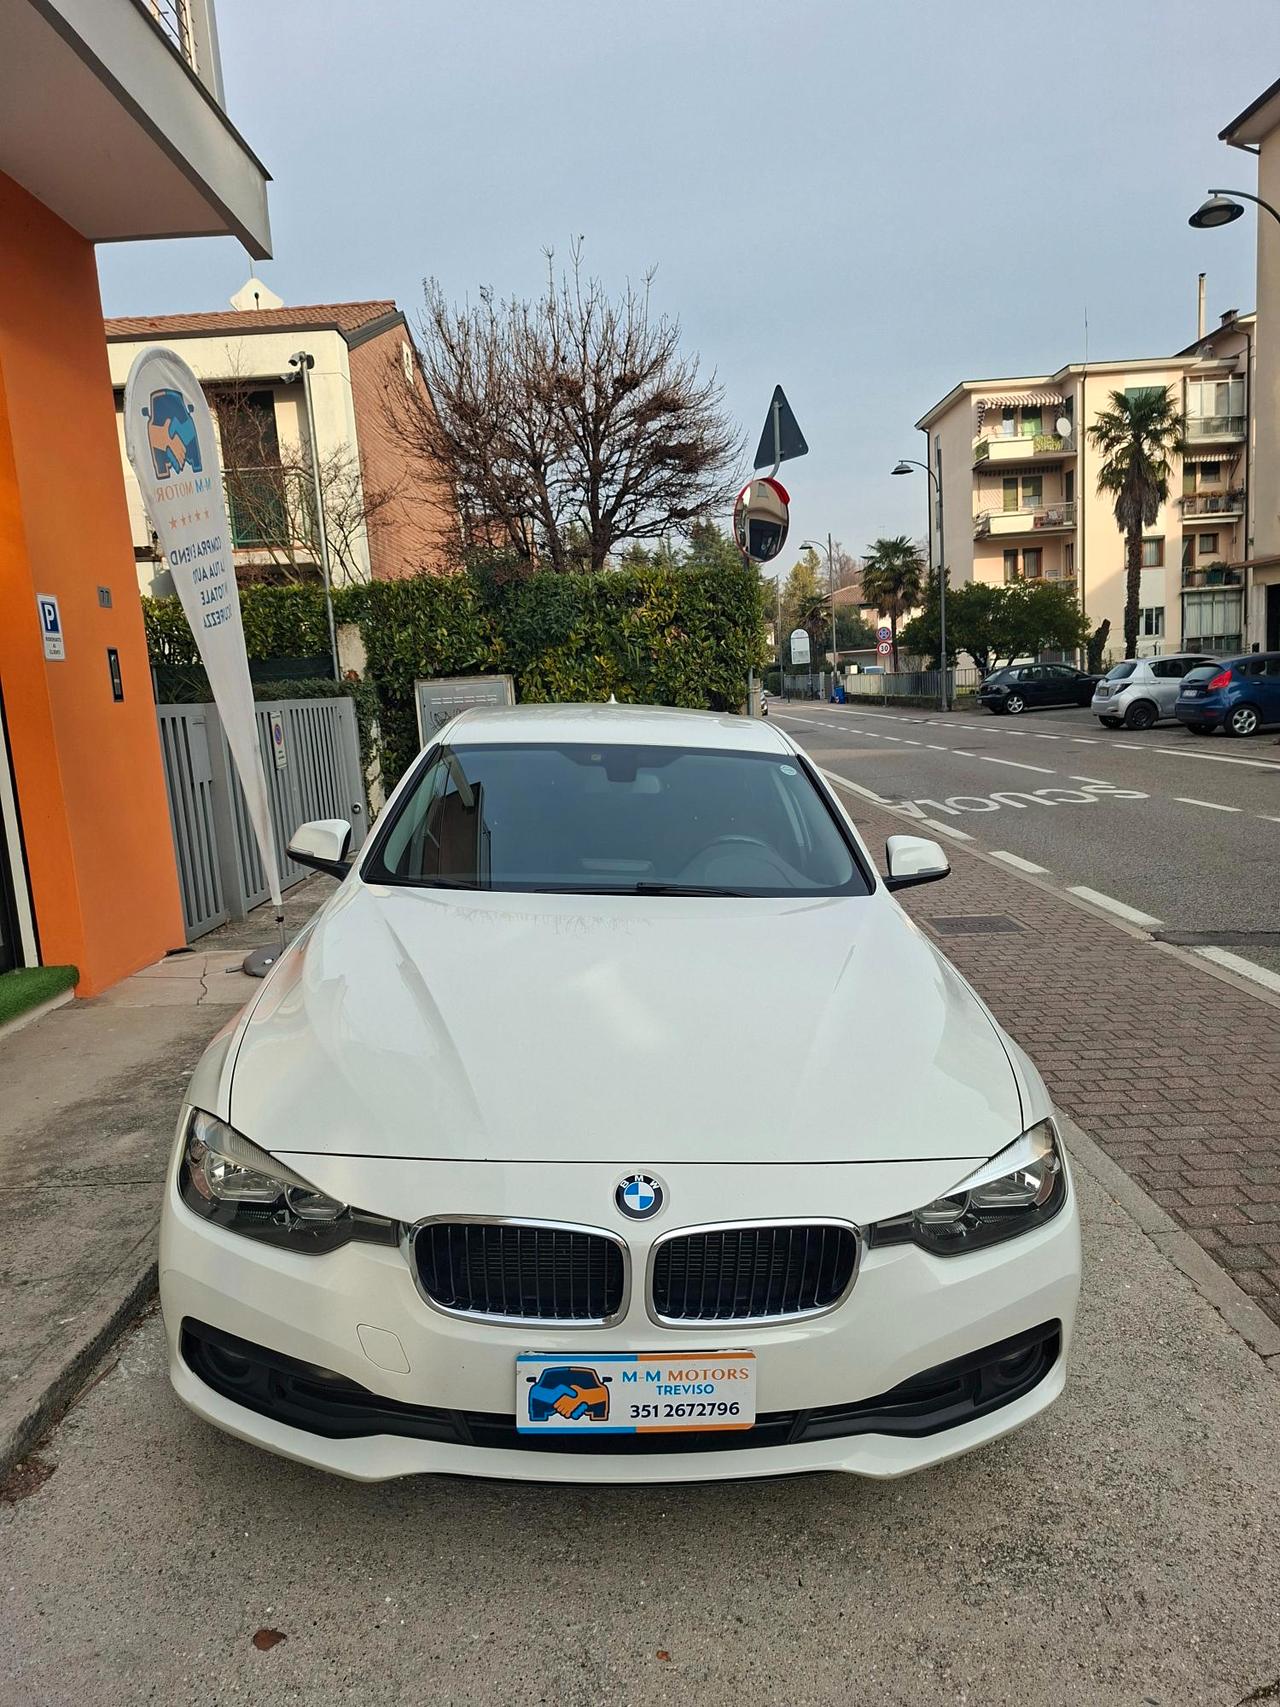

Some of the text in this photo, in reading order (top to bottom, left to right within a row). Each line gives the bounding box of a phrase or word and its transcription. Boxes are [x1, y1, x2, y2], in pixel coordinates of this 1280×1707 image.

[44, 604, 55, 630] P
[889, 784, 1151, 819] SCUOLA
[620, 1175, 660, 1189] BMW
[622, 1368, 749, 1382] M-M MOTORS
[656, 1384, 715, 1396] TREVISO
[630, 1401, 740, 1418] 351 2672796
